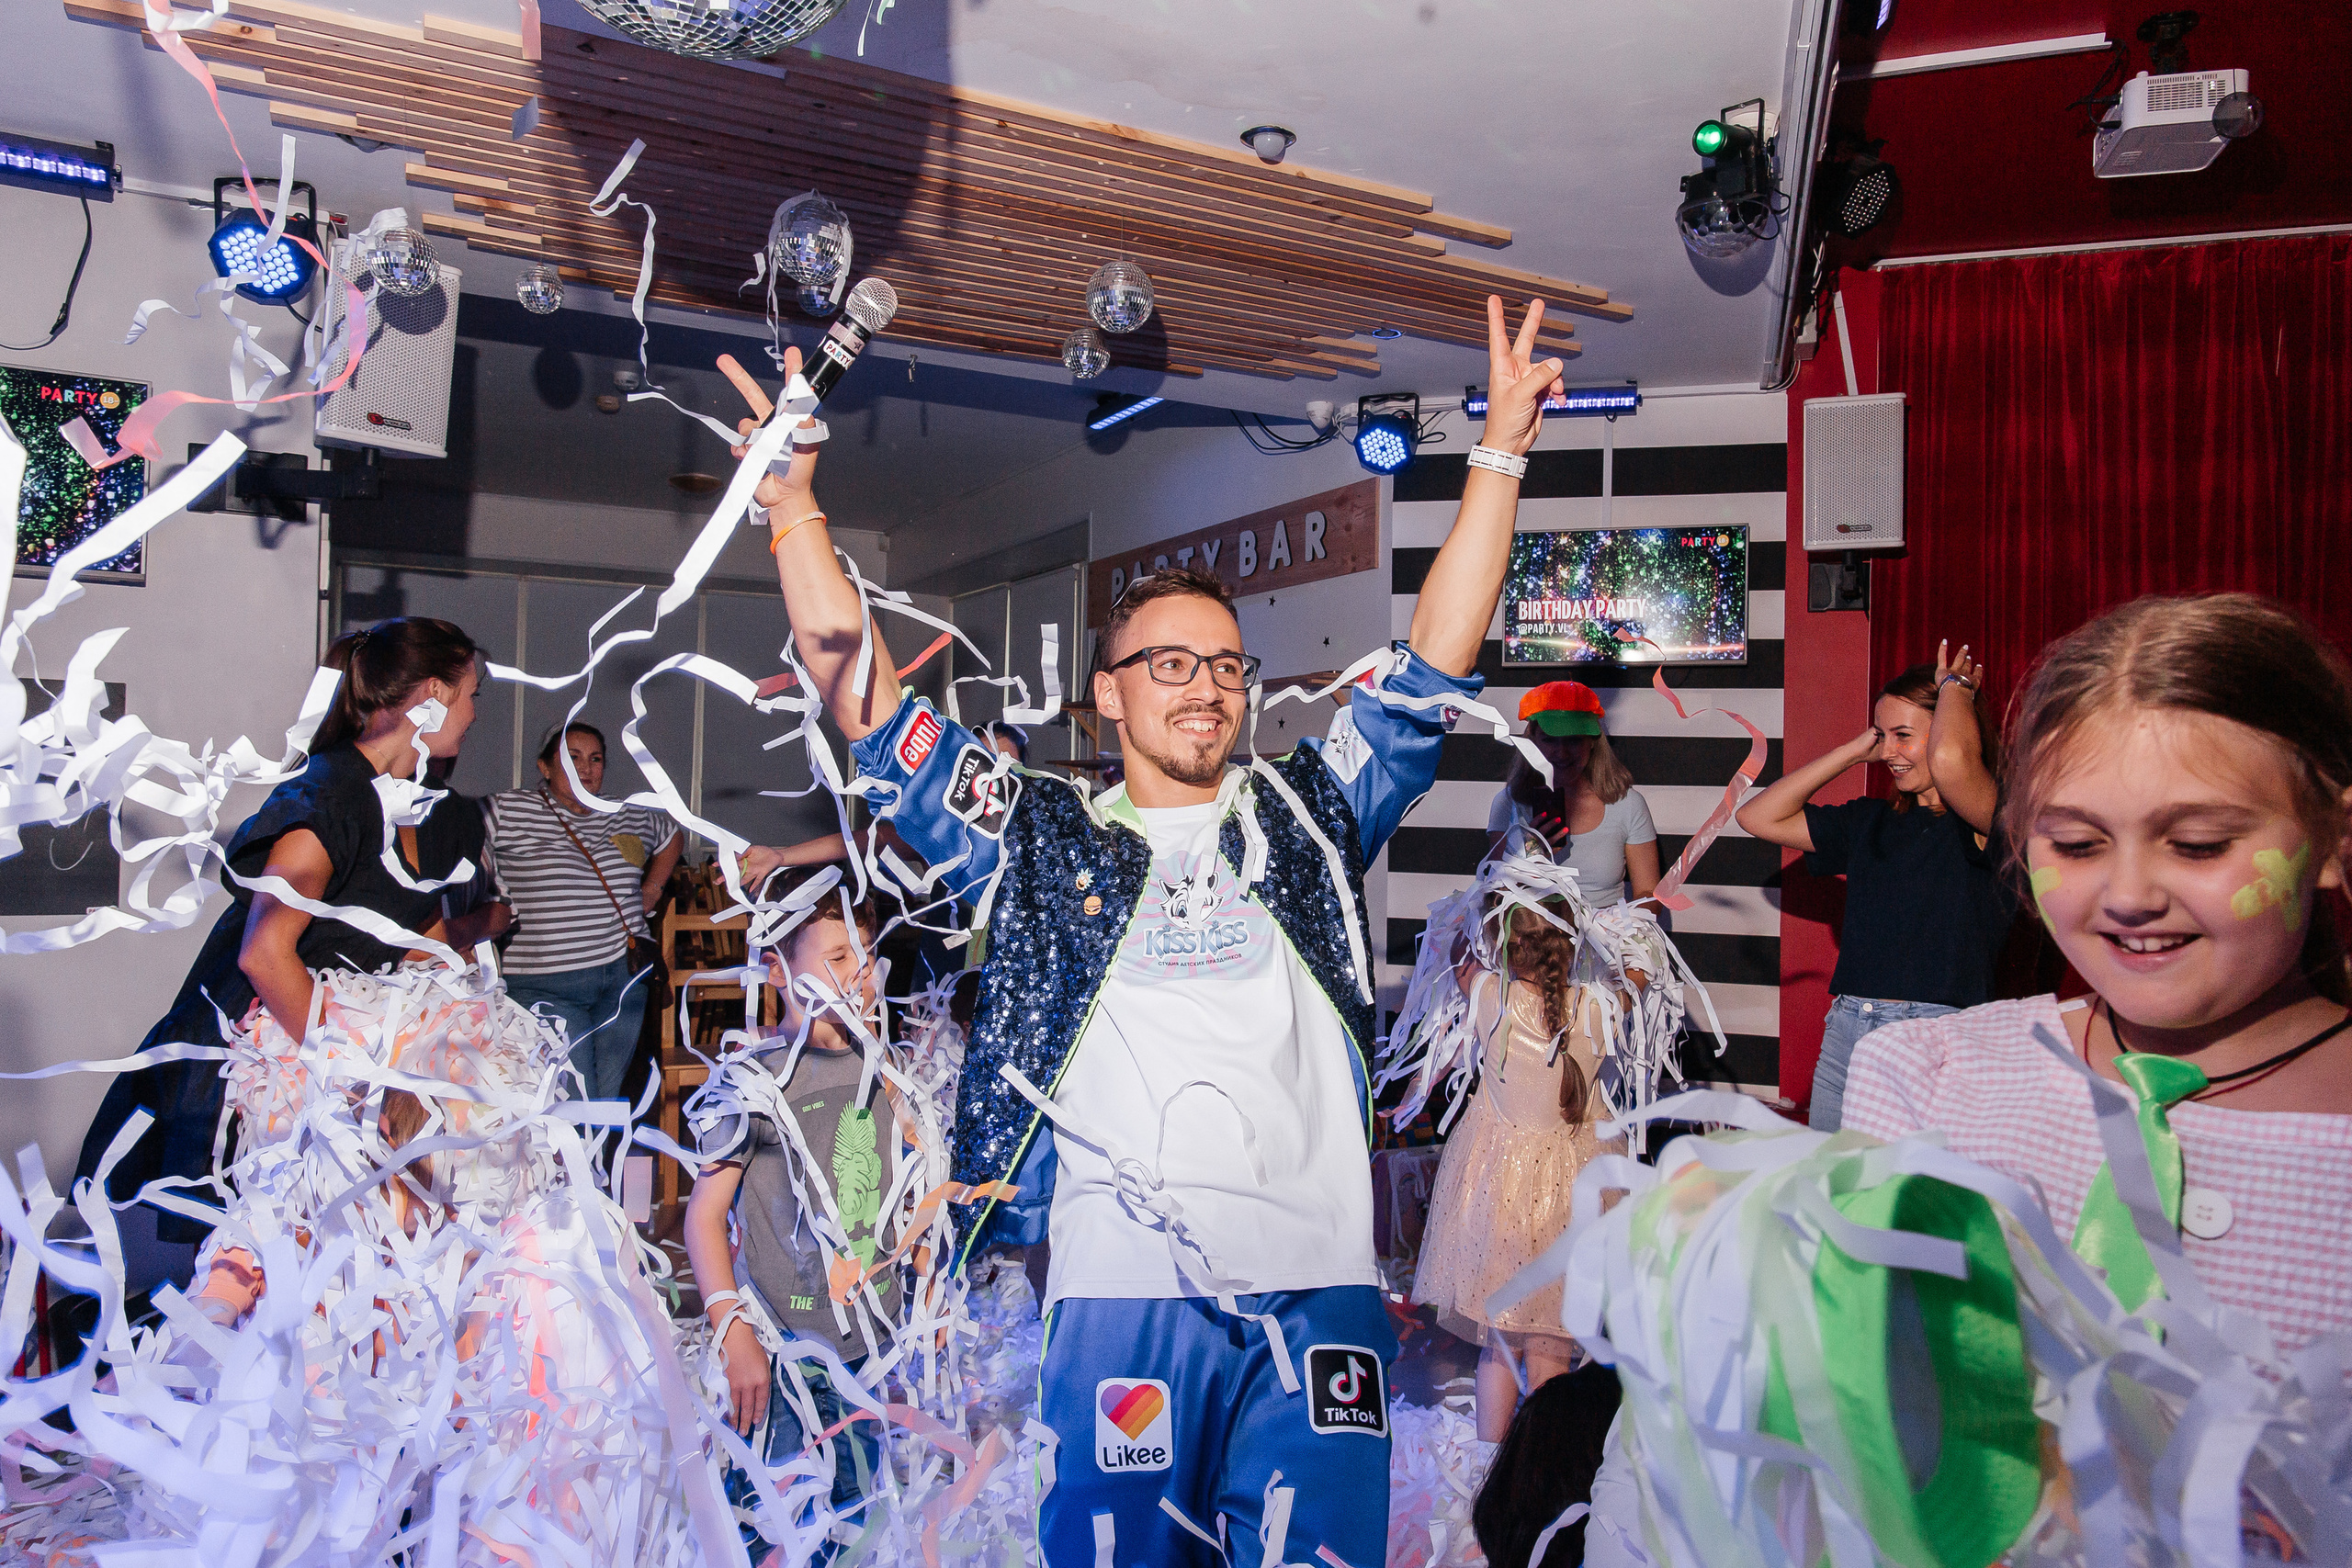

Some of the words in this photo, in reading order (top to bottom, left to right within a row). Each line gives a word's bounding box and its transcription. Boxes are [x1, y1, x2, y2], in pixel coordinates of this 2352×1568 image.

[826, 344, 851, 366] PARTY
[40, 386, 98, 405] PARTY
[1239, 511, 1328, 578] BAR
[1681, 536, 1715, 547] PARTY
[1519, 599, 1590, 620] BIRTHDAY
[1596, 598, 1646, 619] PARTY
[1519, 623, 1567, 634] @PARTY.VL
[954, 757, 980, 801] TikTok
[1205, 953, 1243, 964] ПРАЗДНИКОВ
[790, 1295, 814, 1310] THE
[1324, 1407, 1377, 1426] TikTok
[1103, 1445, 1166, 1467] Likee
